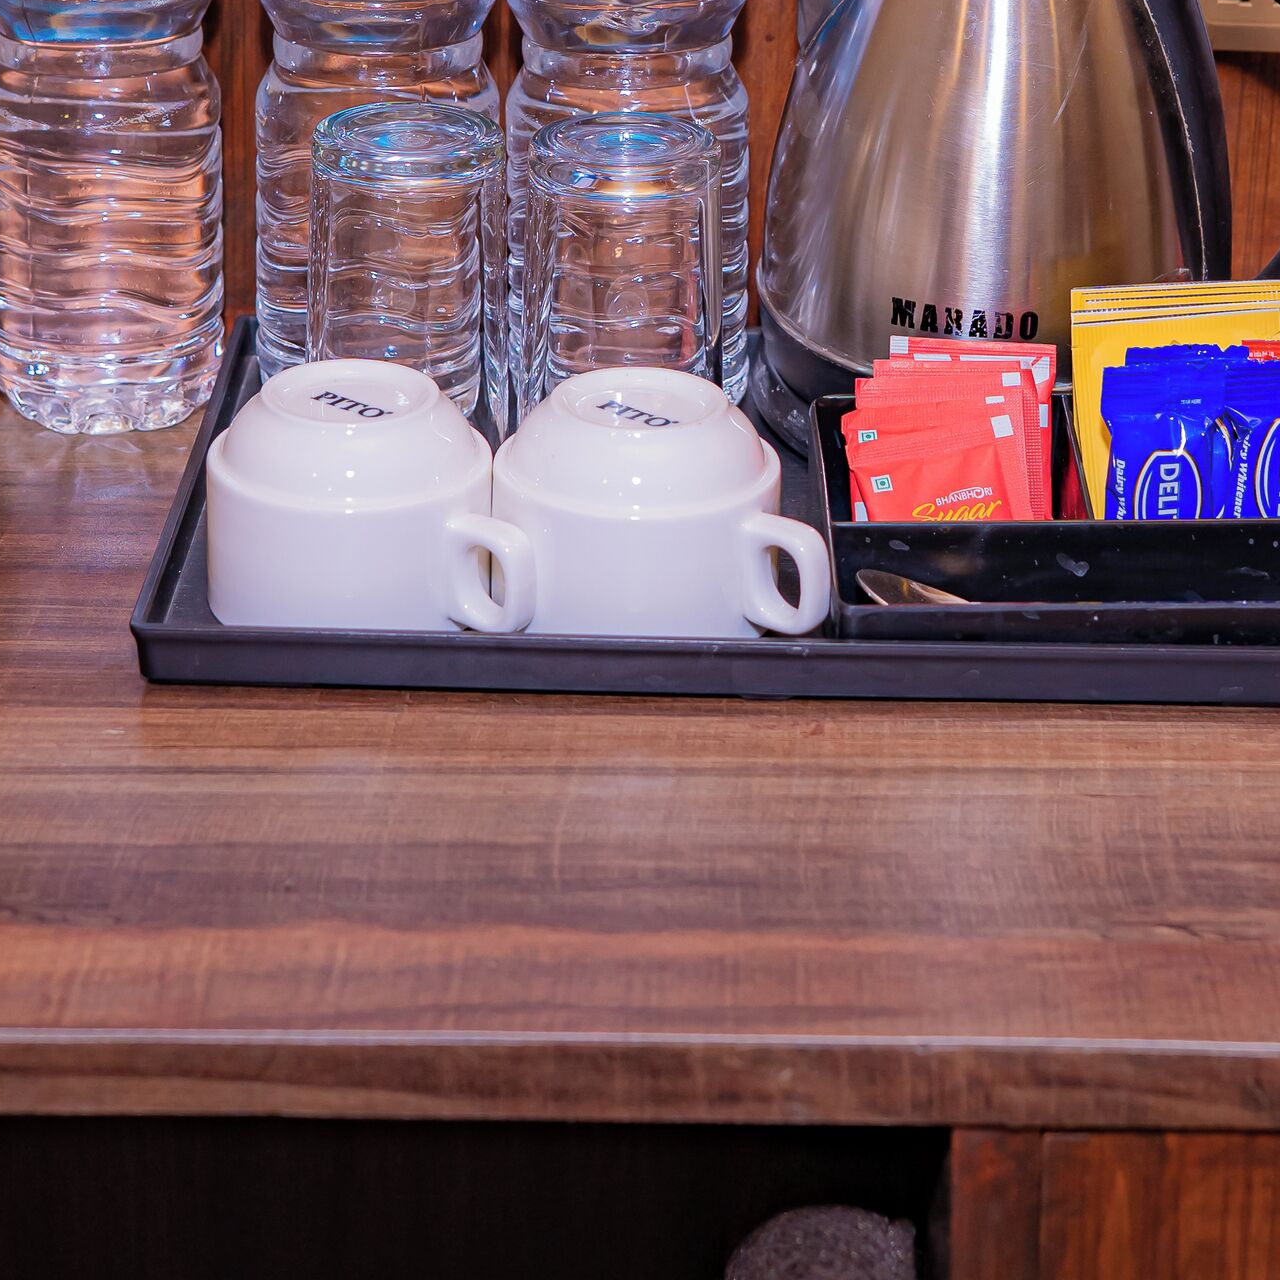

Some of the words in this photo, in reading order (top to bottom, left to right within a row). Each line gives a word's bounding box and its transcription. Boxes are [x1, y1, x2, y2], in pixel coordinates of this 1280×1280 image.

[310, 391, 385, 418] PITO
[595, 400, 671, 427] PITO
[1239, 431, 1252, 460] airy
[1115, 458, 1126, 495] Dairy
[1233, 462, 1249, 519] Whitener
[936, 486, 993, 506] BHANBHORI
[1157, 463, 1180, 520] DELI
